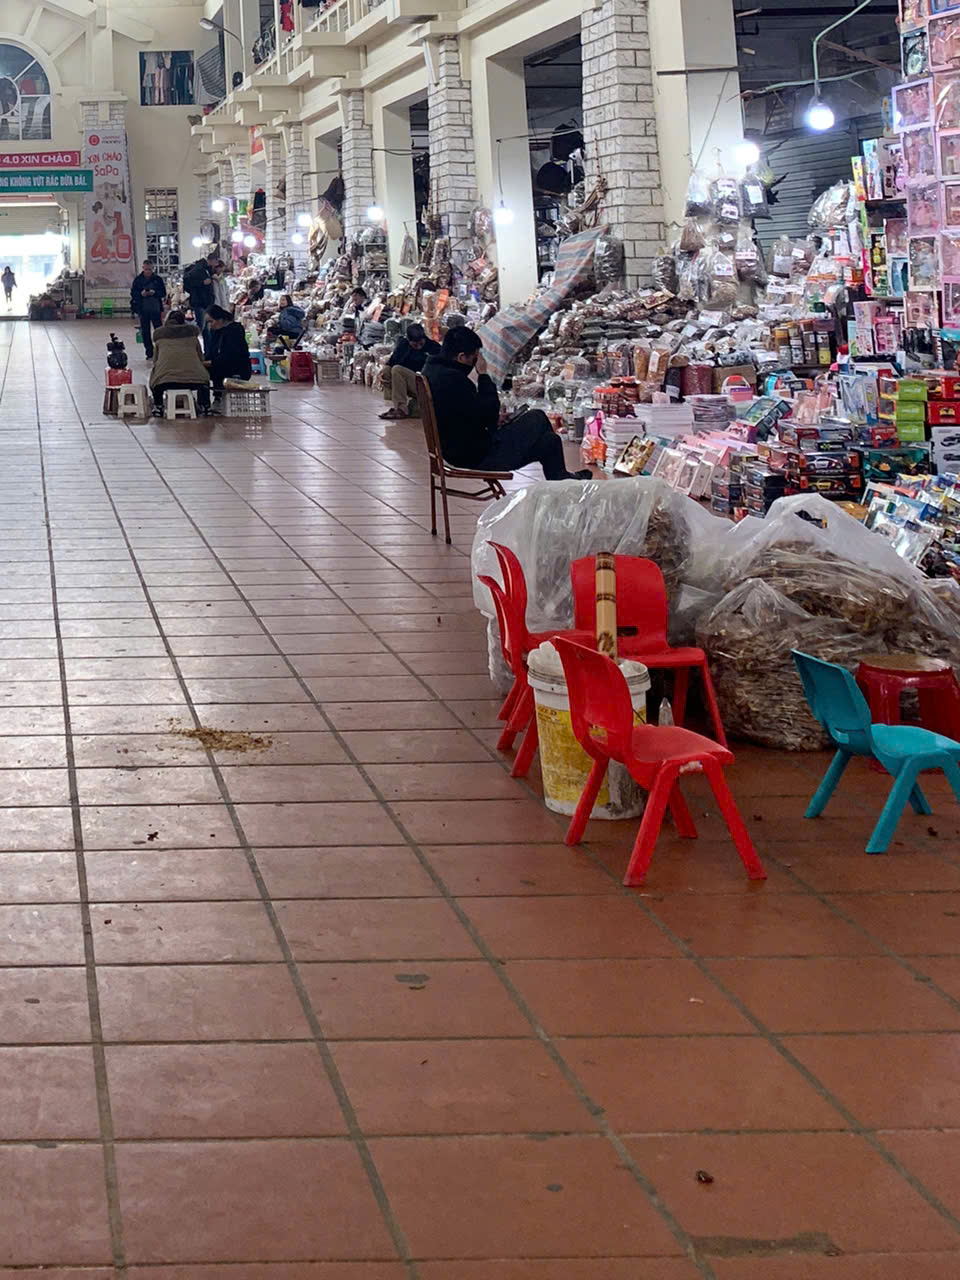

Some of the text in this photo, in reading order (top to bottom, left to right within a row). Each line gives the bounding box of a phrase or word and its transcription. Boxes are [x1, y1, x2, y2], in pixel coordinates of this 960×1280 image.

[2, 155, 19, 164] 4.0
[21, 155, 40, 163] XIN
[41, 152, 72, 163] CHÀO
[94, 164, 119, 176] SaPa
